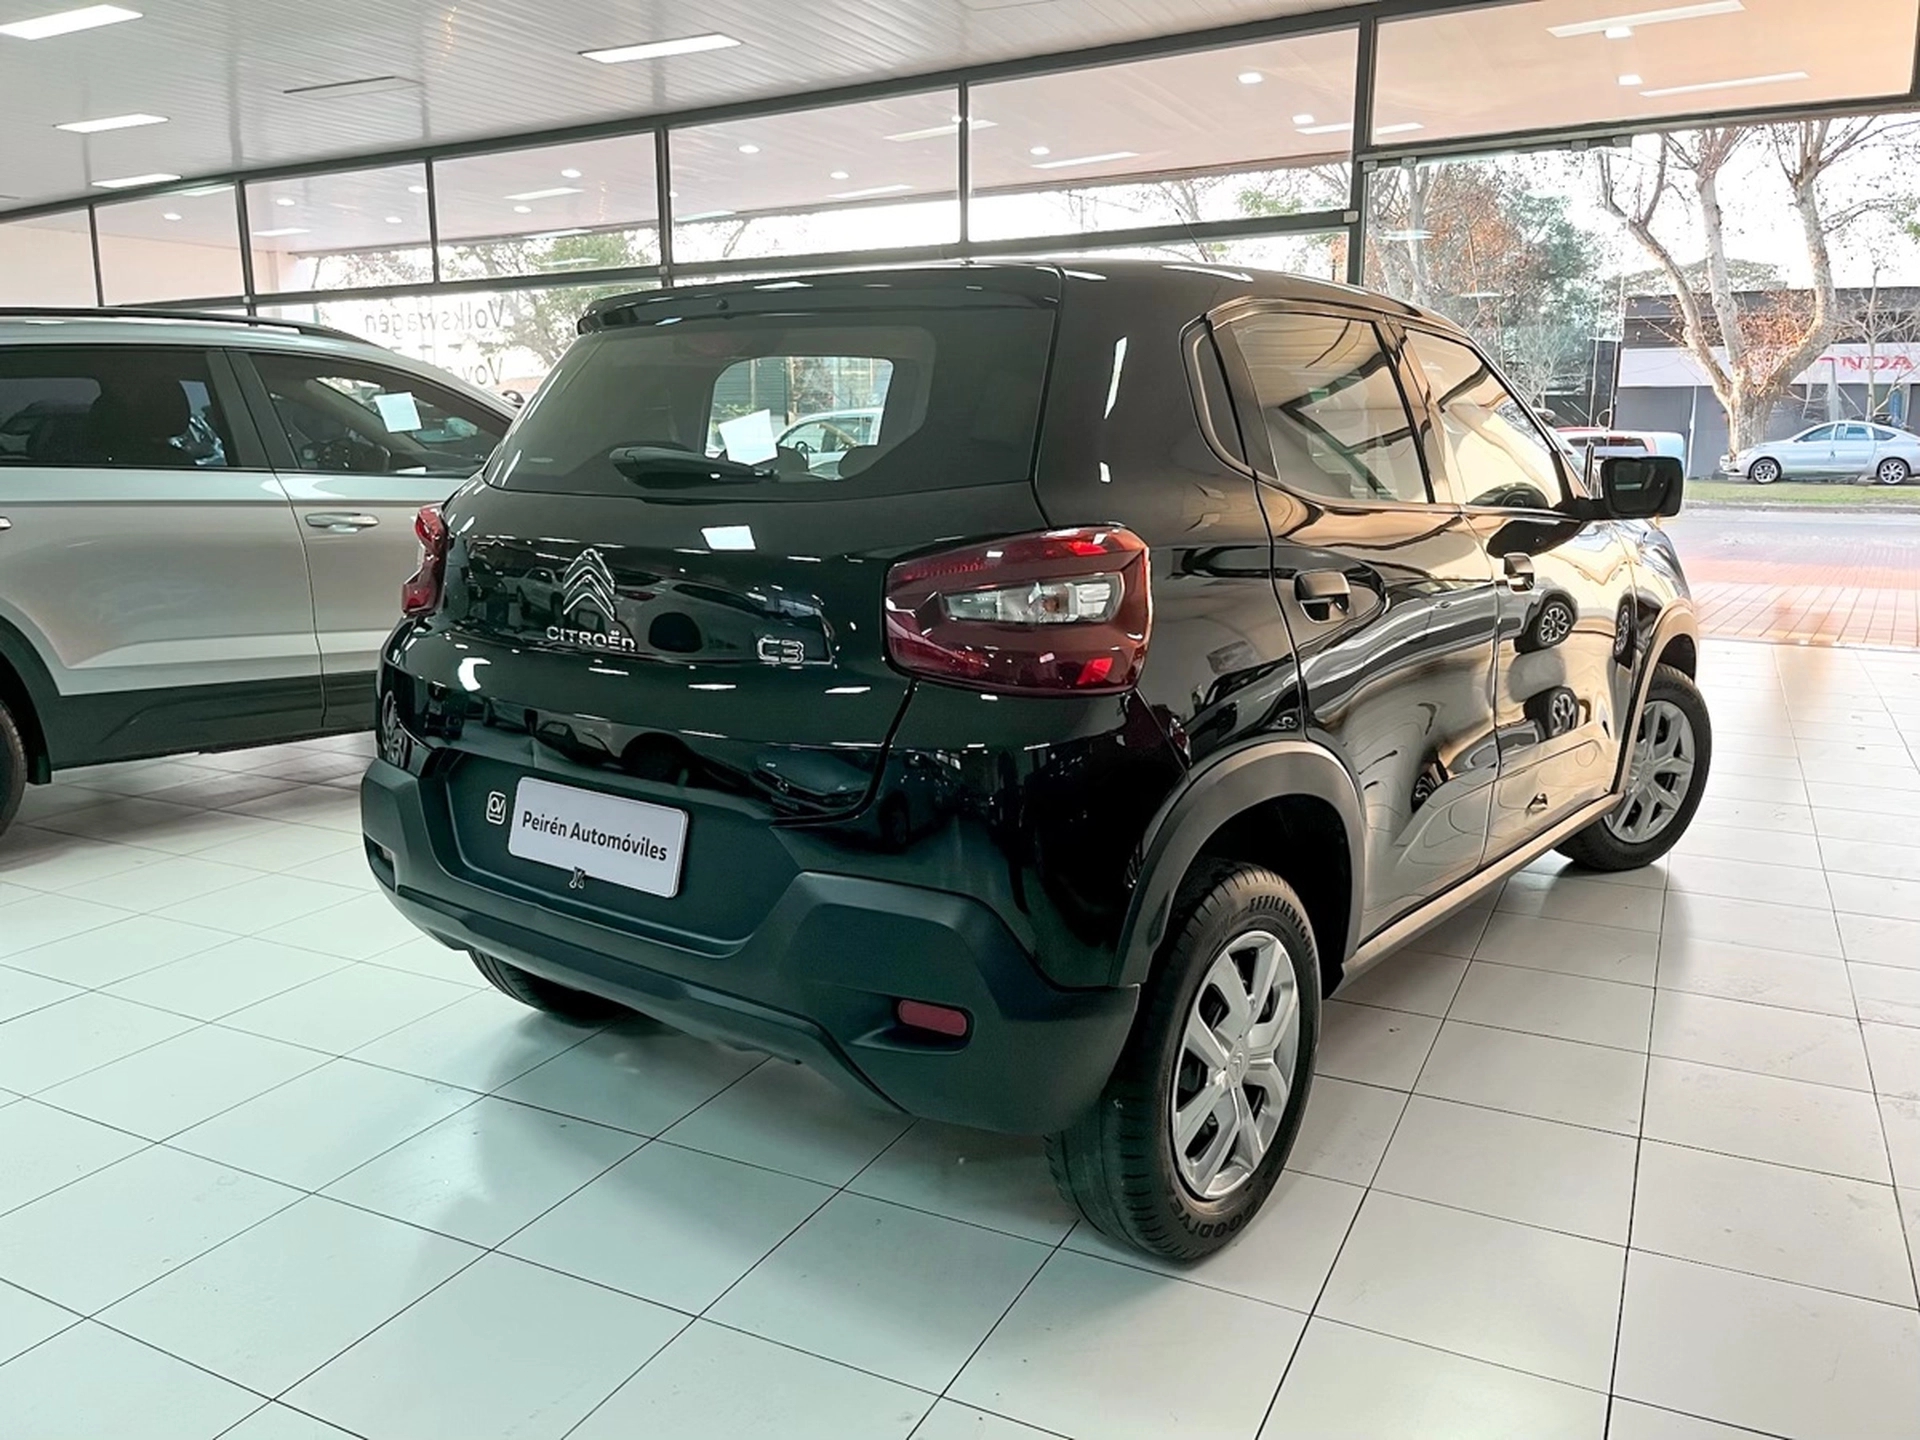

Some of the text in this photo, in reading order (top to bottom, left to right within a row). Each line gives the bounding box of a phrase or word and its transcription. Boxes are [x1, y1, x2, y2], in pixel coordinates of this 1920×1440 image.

[757, 636, 805, 664] C3
[521, 811, 668, 862] Peirén Automóviles
